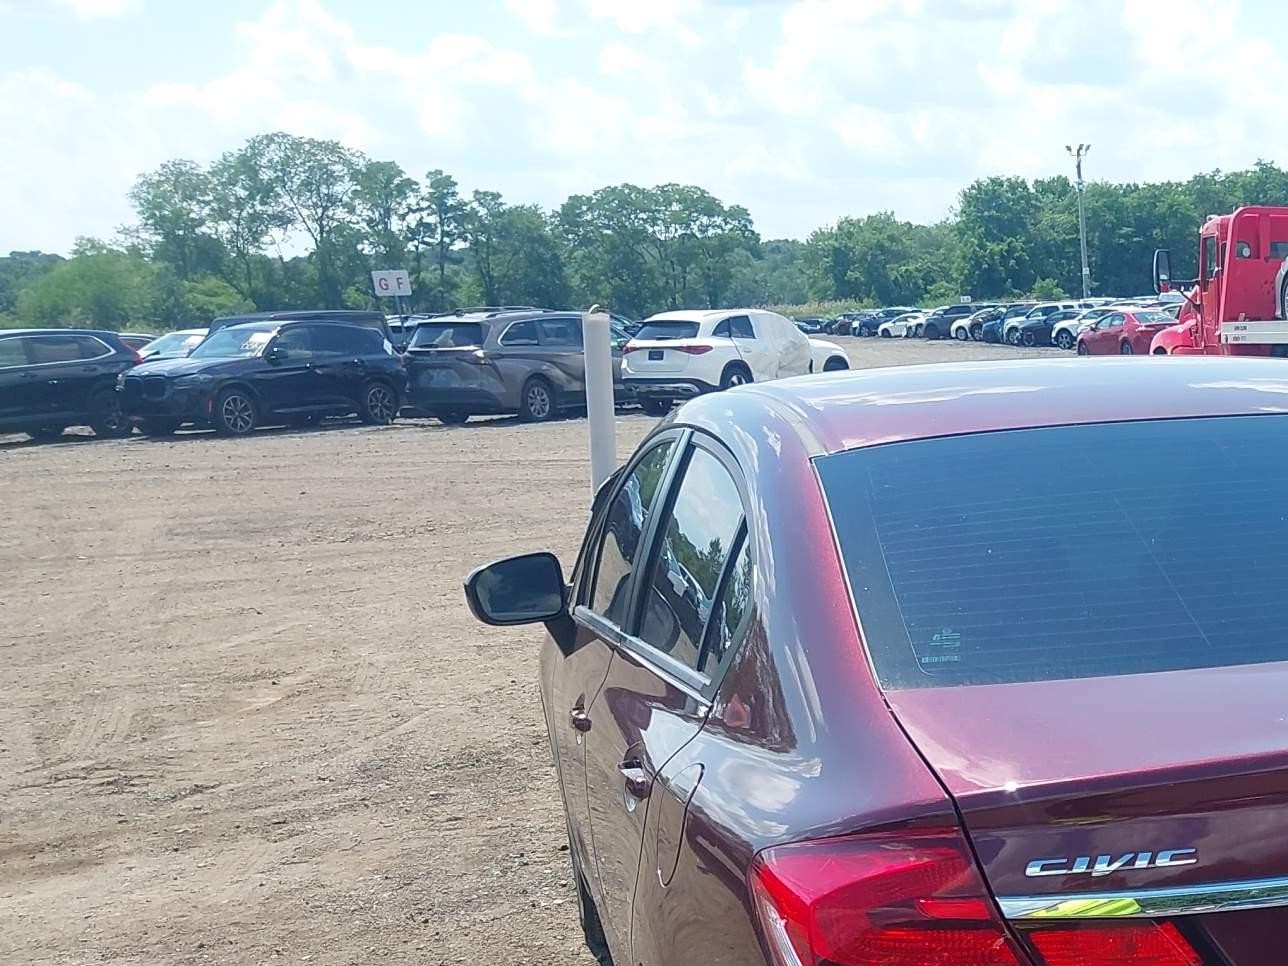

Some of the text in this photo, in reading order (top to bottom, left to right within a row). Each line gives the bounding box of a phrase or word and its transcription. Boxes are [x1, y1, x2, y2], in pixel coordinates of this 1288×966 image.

[378, 276, 404, 291] G F
[1025, 848, 1198, 877] CIVIC
